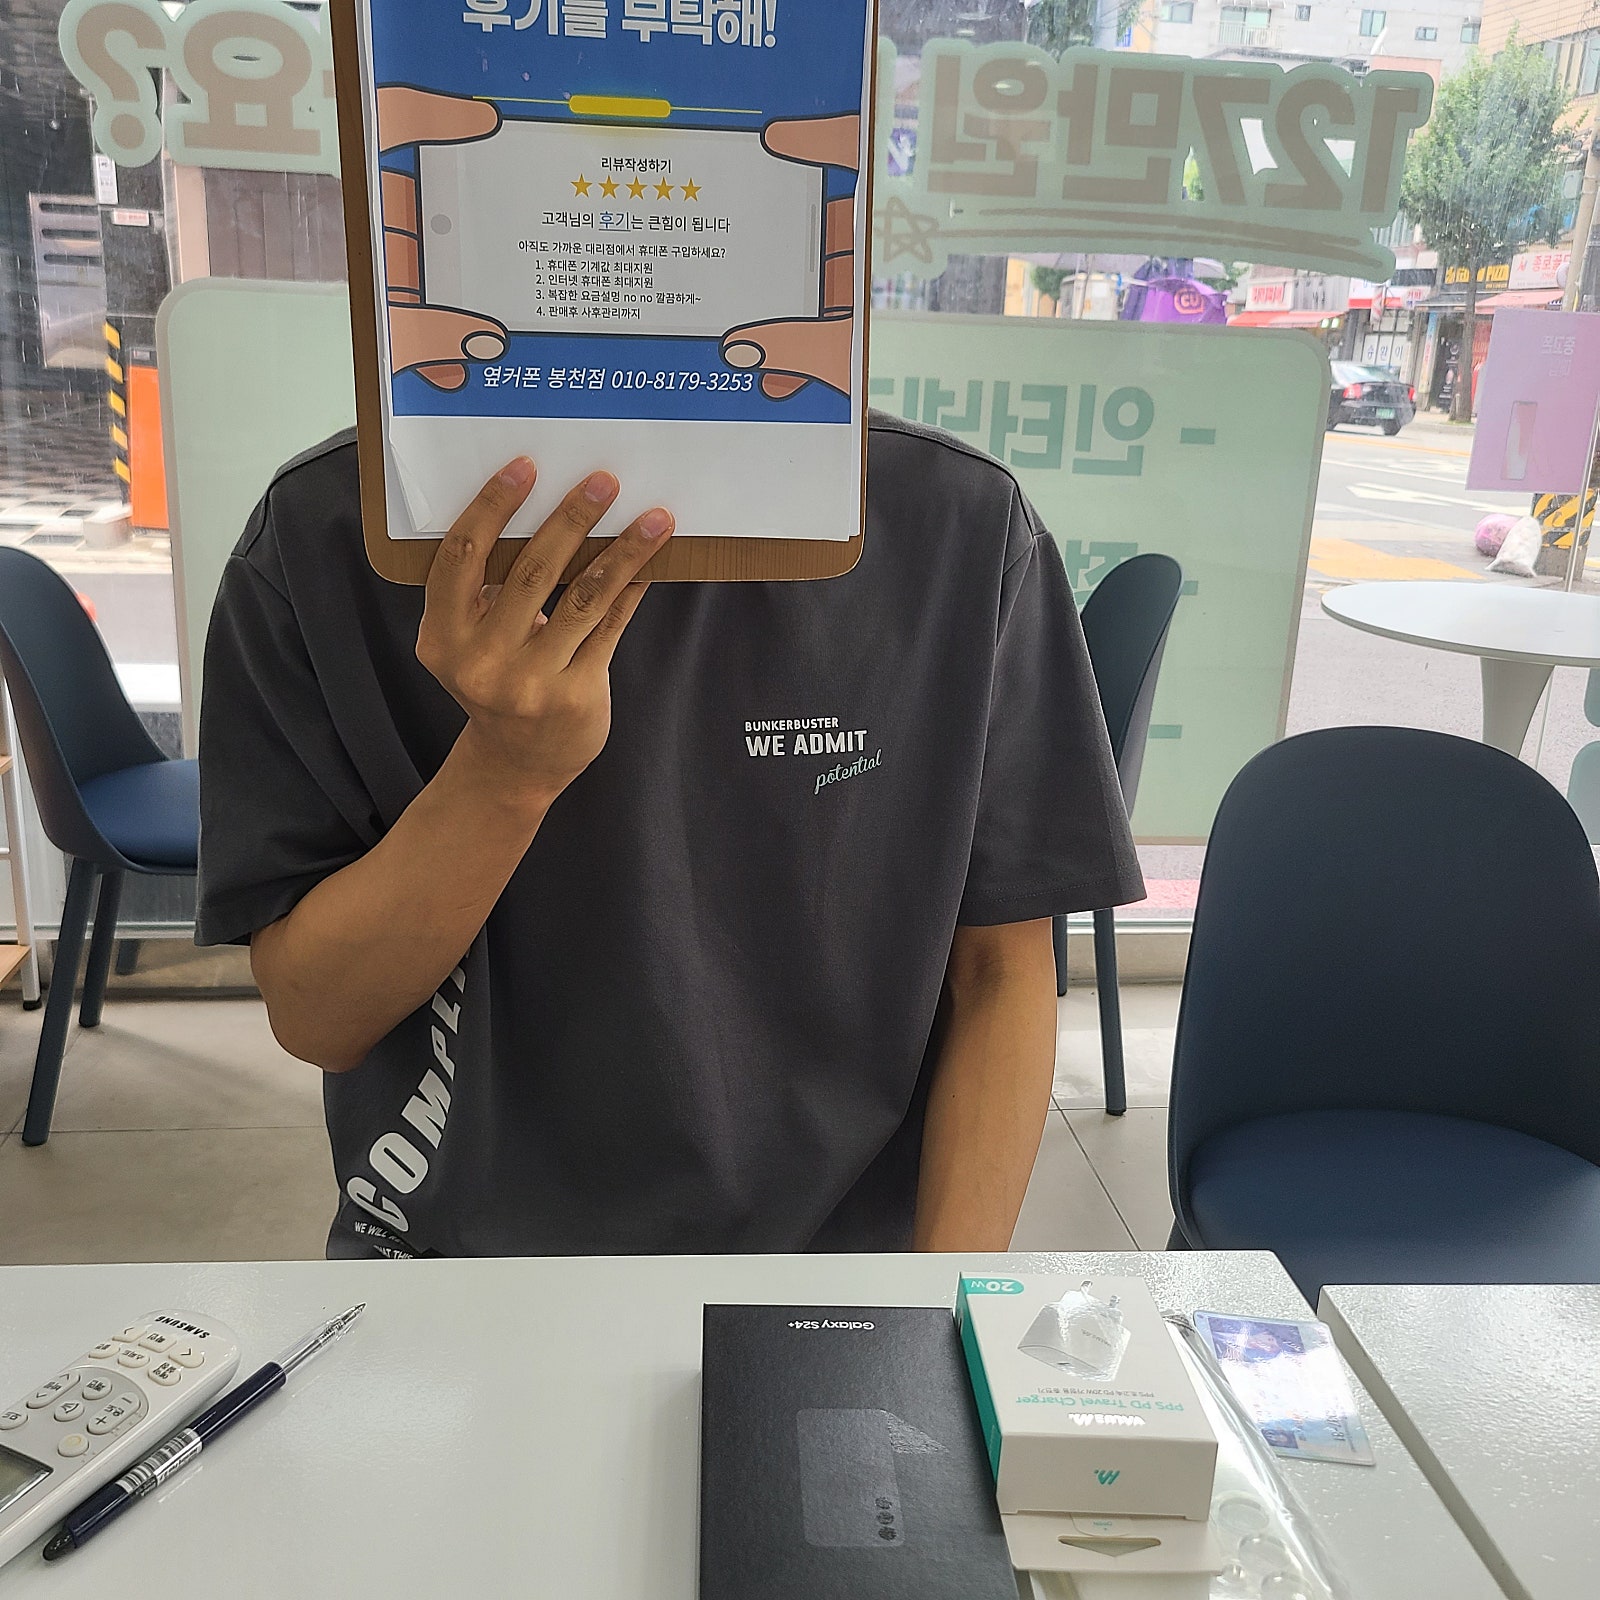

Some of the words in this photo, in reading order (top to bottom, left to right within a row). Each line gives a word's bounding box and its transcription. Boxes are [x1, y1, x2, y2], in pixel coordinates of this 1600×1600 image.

[601, 157, 672, 173] 리뷰작성하기
[541, 211, 595, 229] 고객님의
[598, 210, 644, 231] 후기는
[648, 215, 687, 232] 큰힘이
[691, 216, 731, 233] 됩니다
[518, 240, 549, 253] 아직도
[552, 241, 583, 255] 가까운
[585, 243, 635, 257] 대리점에서
[638, 244, 669, 258] 휴대폰
[671, 246, 726, 259] 구입하세요?
[535, 260, 545, 270] 1.
[547, 260, 578, 272] 휴대폰
[580, 261, 611, 273] 기계값
[613, 262, 653, 274] 최대지원
[535, 274, 545, 285] 2.
[548, 274, 578, 287] 인터넷
[581, 275, 611, 288] 휴대폰
[614, 276, 653, 289] 최대지원
[535, 289, 545, 300] 3.
[548, 289, 578, 302] 복잡한
[623, 292, 637, 303] no
[640, 293, 653, 303] no
[655, 292, 702, 305] 깔끔하게~
[536, 306, 546, 317] 4.
[548, 306, 578, 318] 판매후
[581, 307, 641, 319] 사후관리까지
[483, 365, 542, 388] 옆커폰
[547, 367, 606, 390] 봉천점
[611, 370, 754, 392] 010-8179-3253
[744, 717, 839, 732] BUNKERBUSTER
[745, 735, 786, 757] WE
[793, 730, 868, 756] ADMIT
[813, 748, 883, 795] potential
[354, 1221, 368, 1234] WE
[155, 1315, 210, 1339] SAMSUNG
[787, 1320, 820, 1330] S24+
[820, 1319, 875, 1330] Galaxy
[1016, 1394, 1077, 1407] Charger
[1081, 1396, 1127, 1409] Travel
[1130, 1400, 1152, 1411] PD
[1155, 1401, 1185, 1412] PPS
[1, 1411, 22, 1421] 모드
[104, 1404, 124, 1417] 온도
